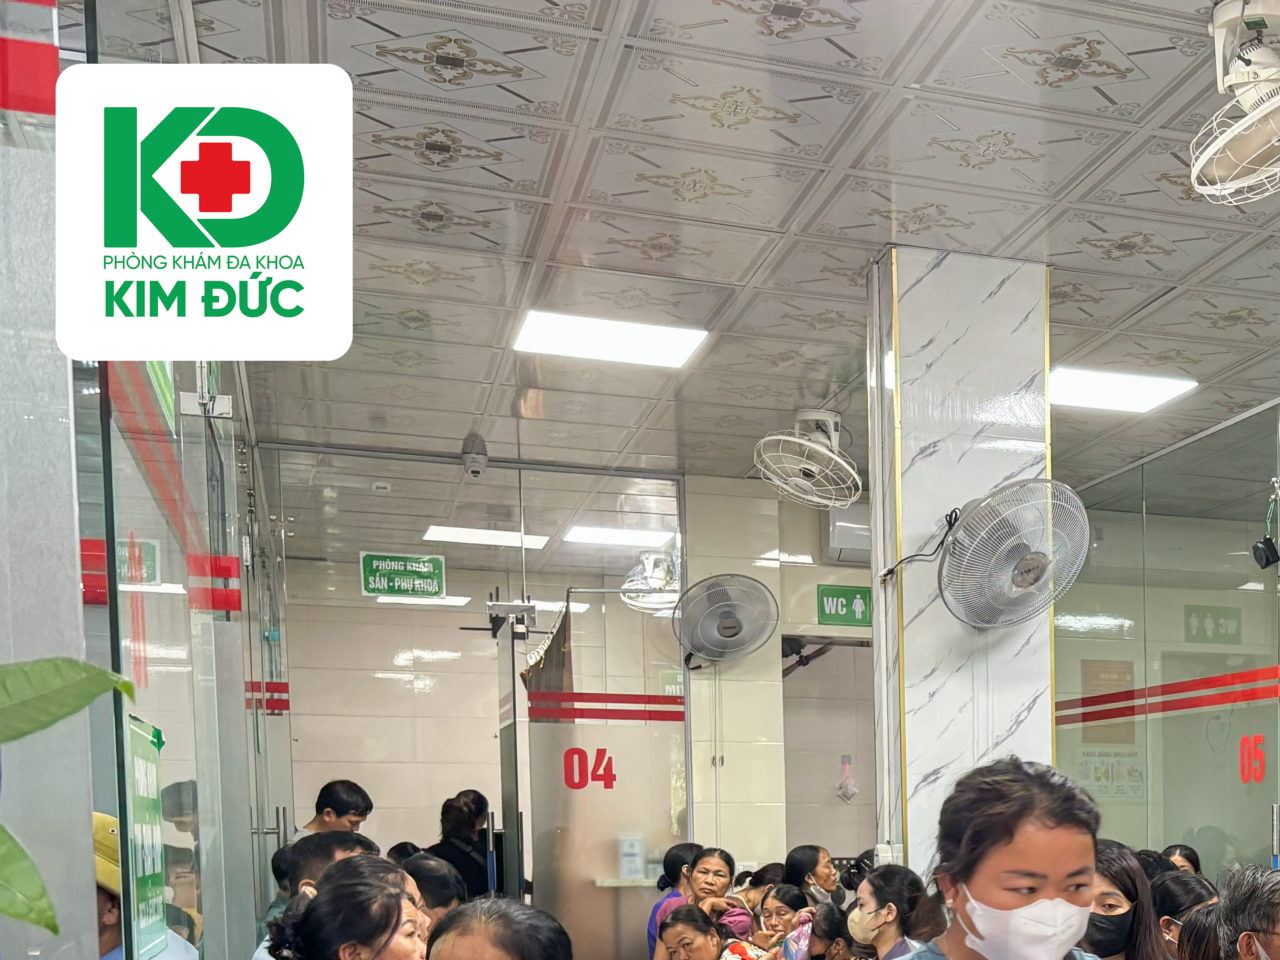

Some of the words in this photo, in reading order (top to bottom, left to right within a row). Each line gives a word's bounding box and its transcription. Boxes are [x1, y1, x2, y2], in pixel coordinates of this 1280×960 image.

[373, 558, 405, 571] PHÒNG
[369, 572, 388, 590] SẢN
[395, 577, 413, 594] PHỤ
[823, 597, 847, 615] WC
[563, 747, 617, 790] 04
[1240, 734, 1266, 785] 05
